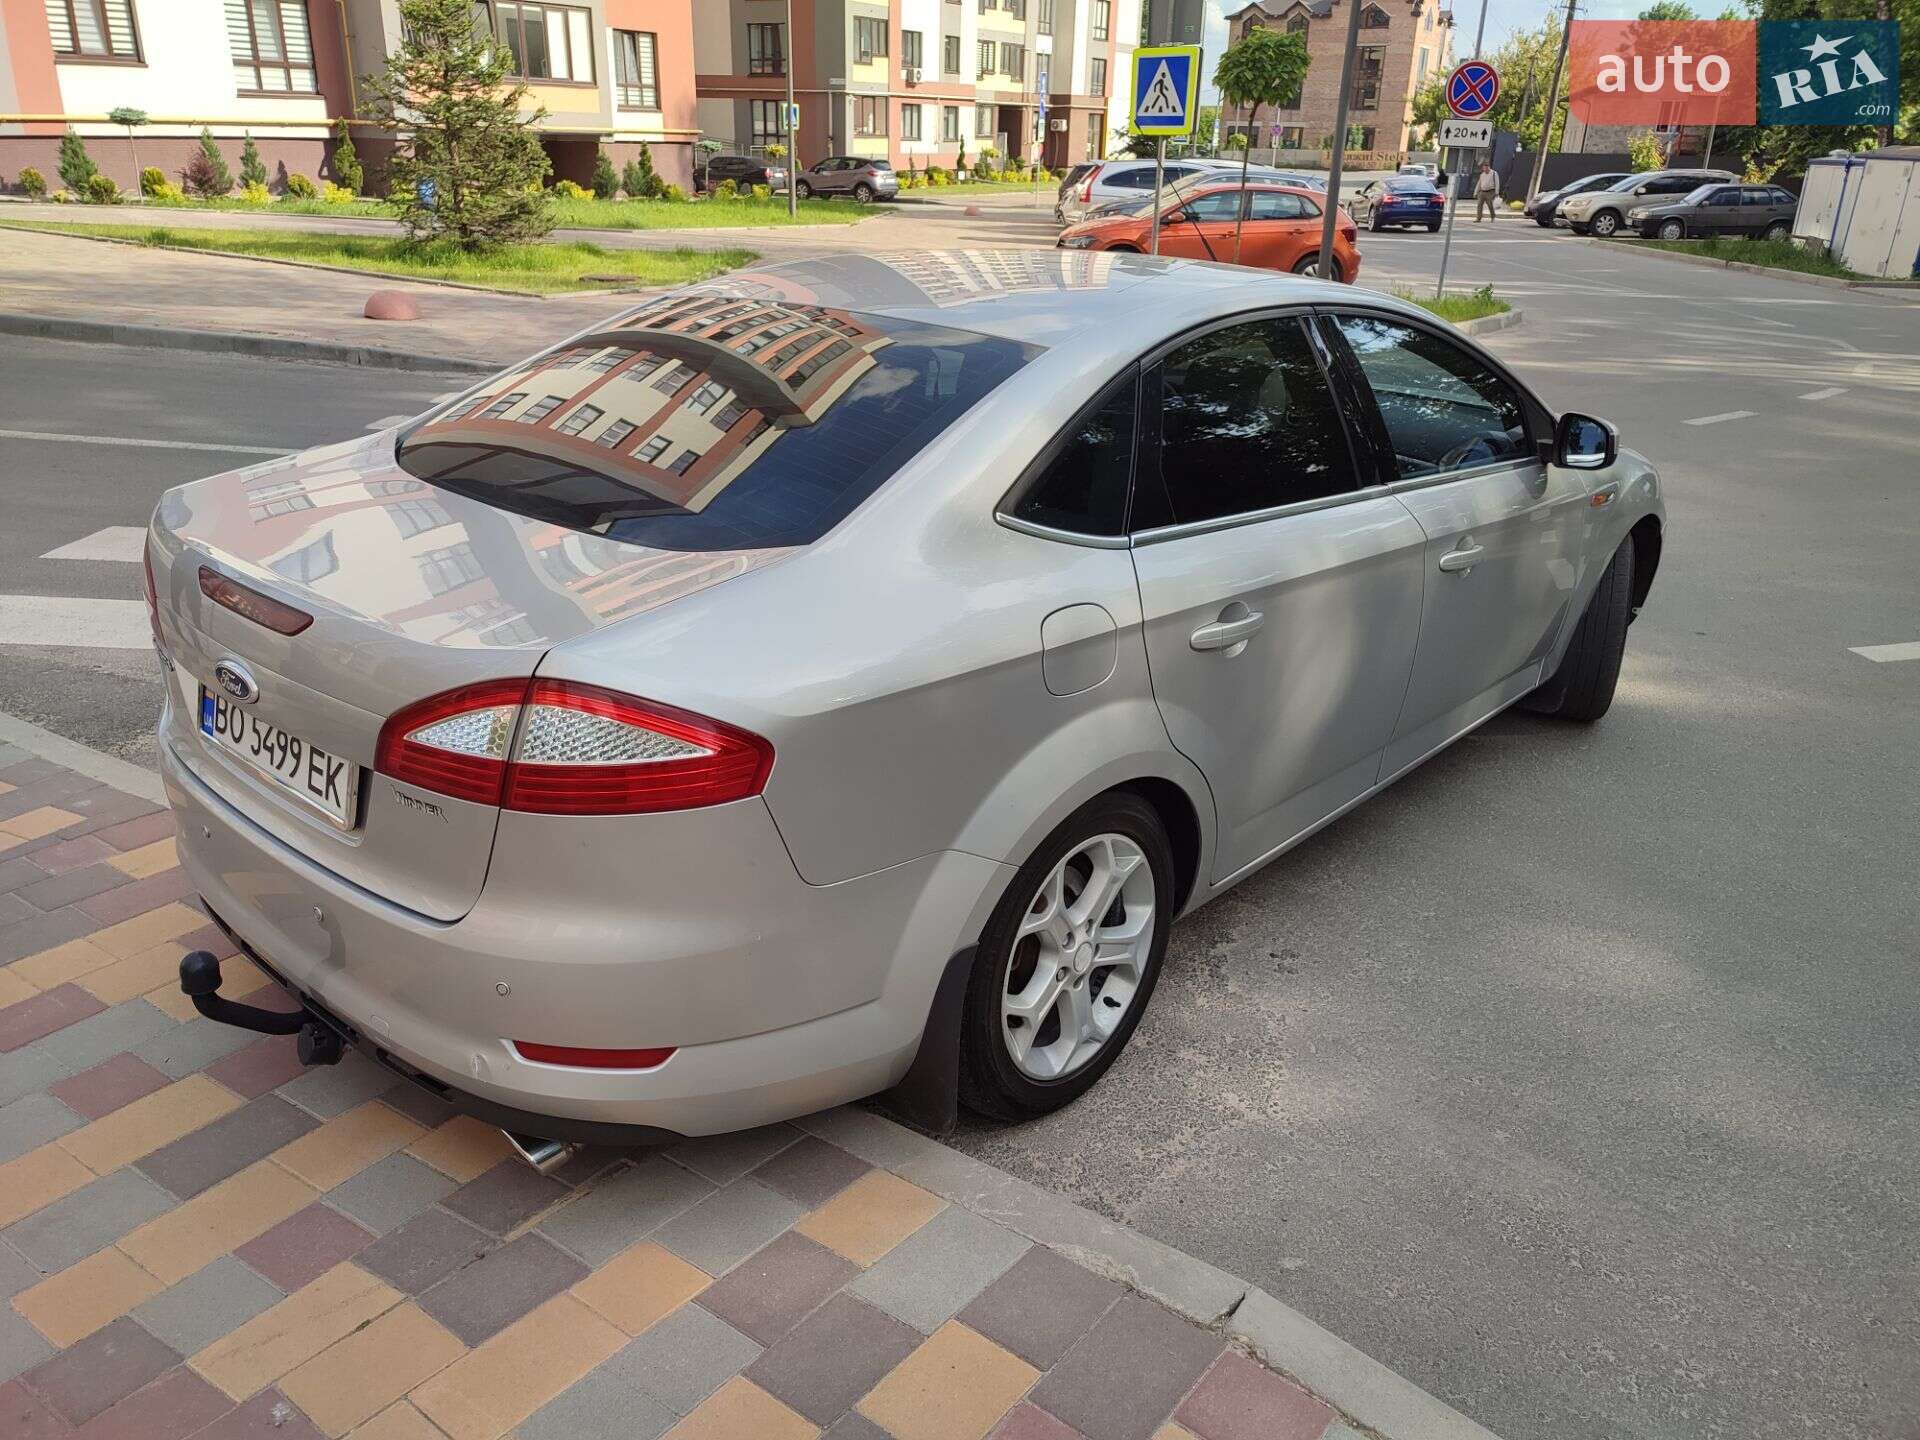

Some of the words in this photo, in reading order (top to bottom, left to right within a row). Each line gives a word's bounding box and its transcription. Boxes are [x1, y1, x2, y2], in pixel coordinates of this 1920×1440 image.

[1453, 127, 1469, 139] 20
[215, 693, 244, 744] BO
[250, 717, 302, 778] 5499
[307, 744, 344, 808] EK
